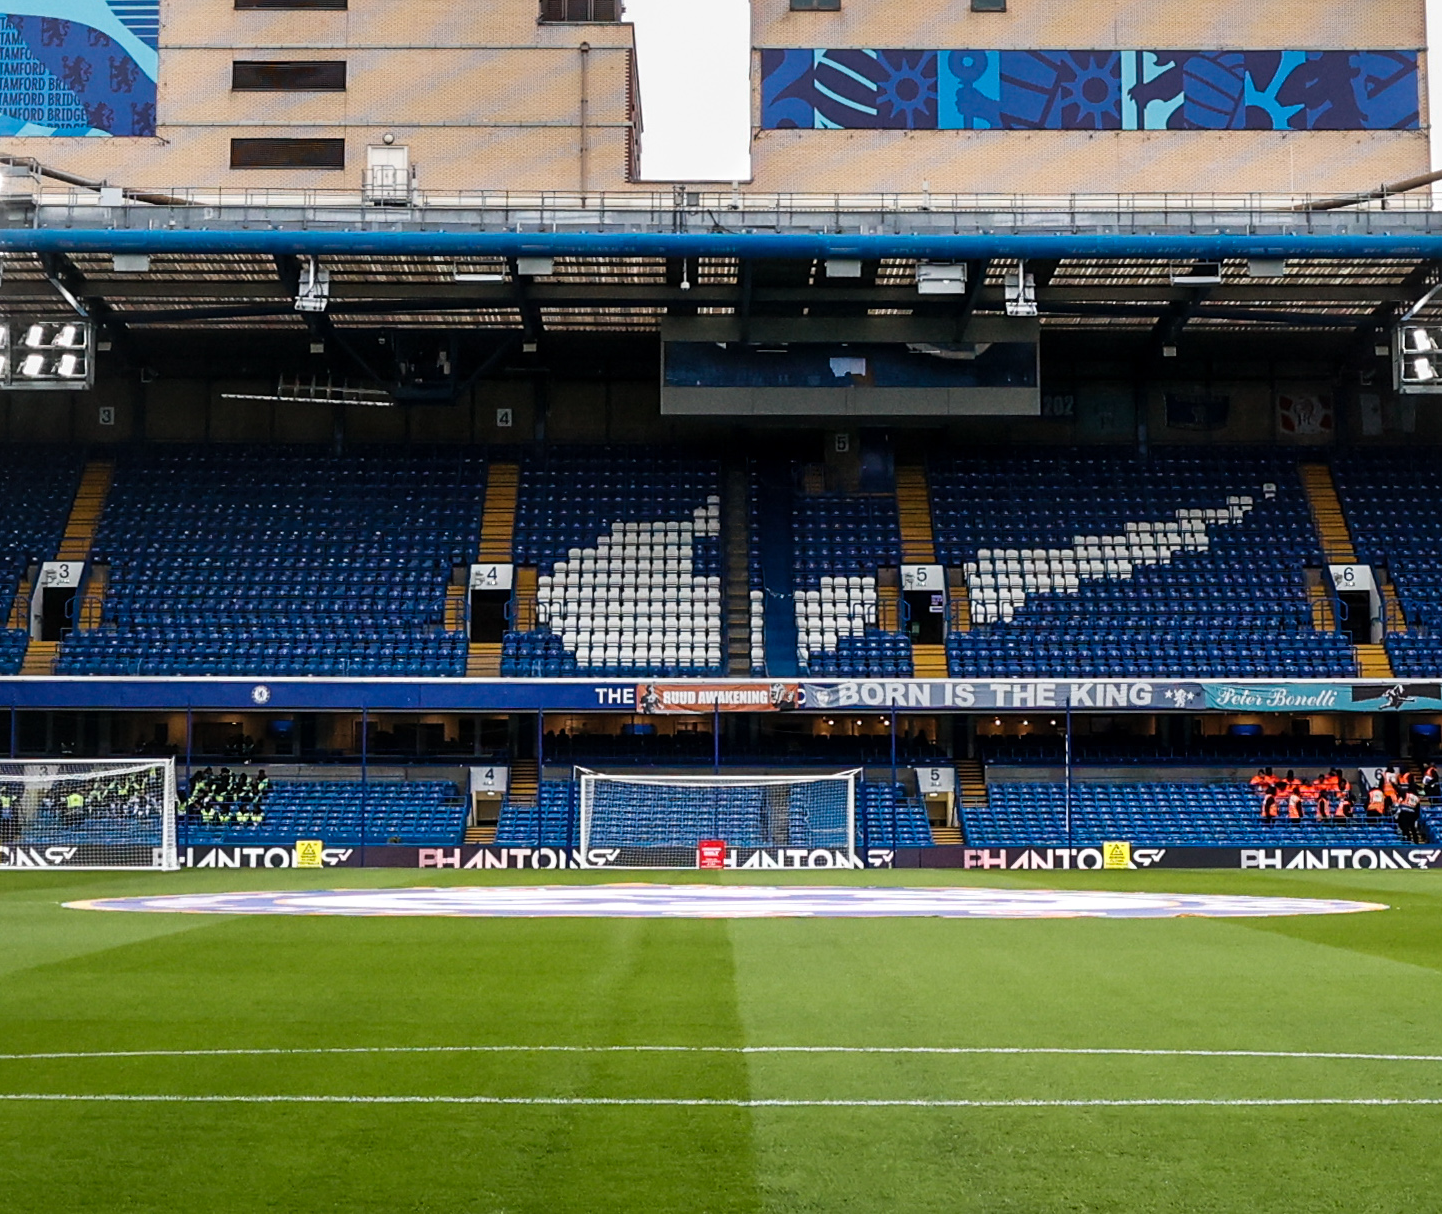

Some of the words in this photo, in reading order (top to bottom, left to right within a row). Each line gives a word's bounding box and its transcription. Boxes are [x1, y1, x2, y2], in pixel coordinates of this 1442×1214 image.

[47, 108, 88, 121] BRIDGE
[101, 409, 111, 423] 3
[499, 411, 510, 425] 4
[837, 436, 846, 450] 5
[59, 563, 69, 578] 3
[486, 566, 497, 581] 4
[916, 567, 927, 582] 5
[1343, 566, 1355, 582] 6
[595, 688, 634, 704] THE
[663, 690, 696, 705] RUUD
[698, 689, 769, 705] AWAKENING
[838, 682, 931, 708] BORN
[944, 682, 975, 707] IS
[990, 683, 1058, 707] THE
[1070, 682, 1153, 708] KING
[1217, 687, 1262, 705] Peter
[485, 767, 494, 781] 4
[930, 769, 940, 782] 5
[1374, 769, 1383, 781] 6
